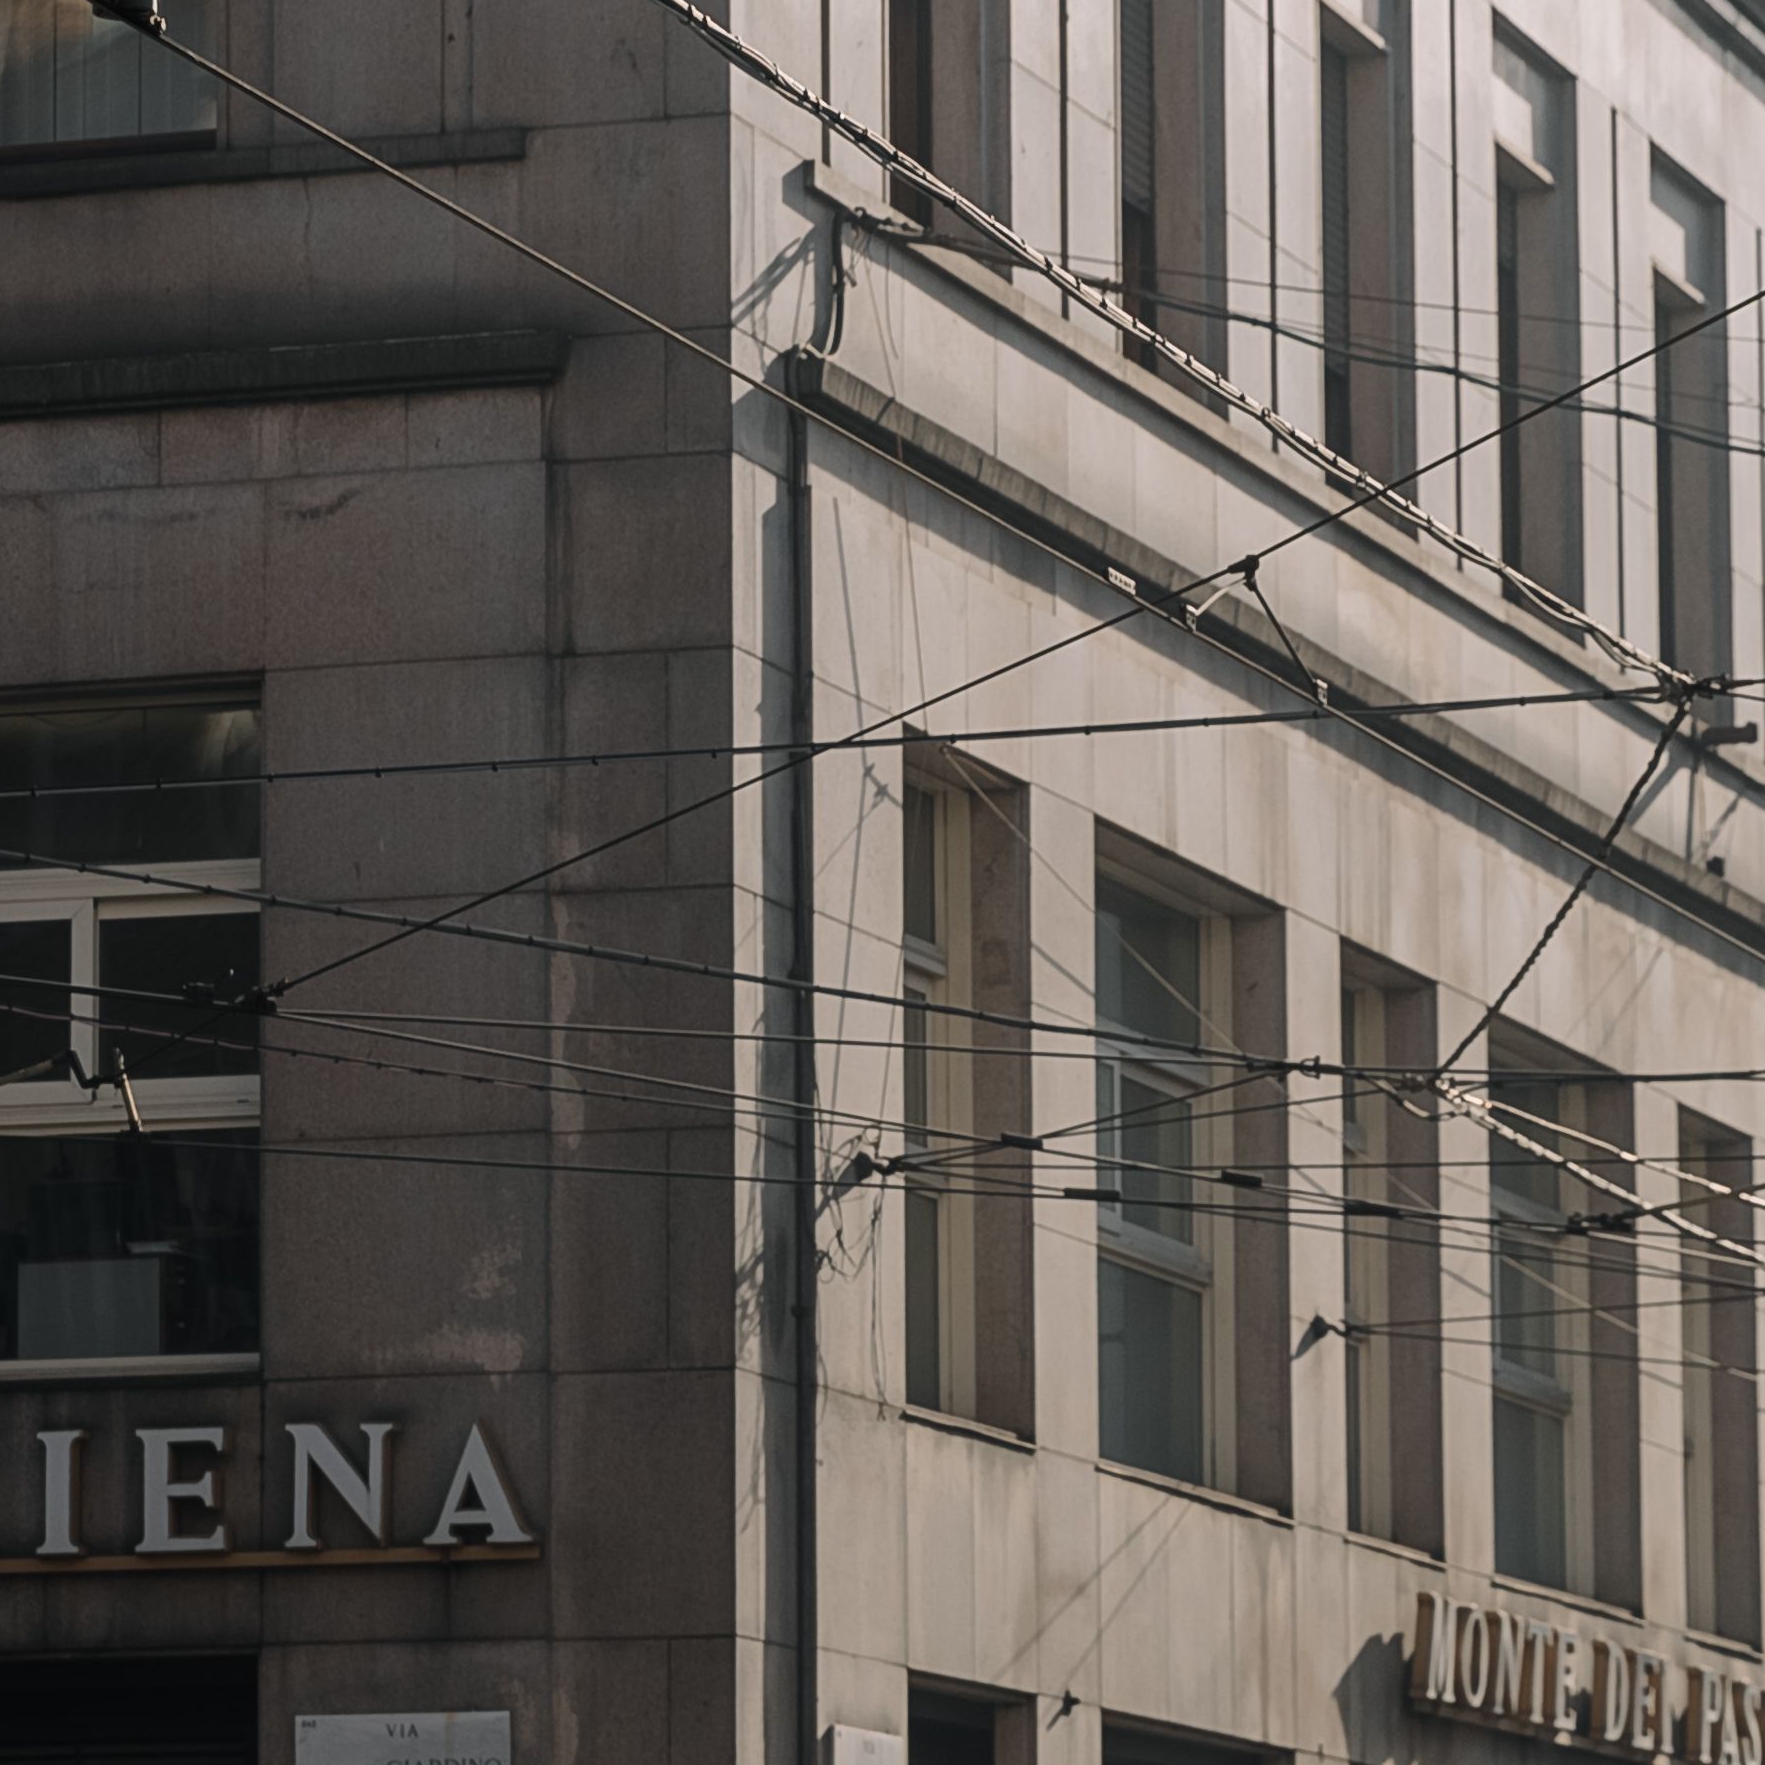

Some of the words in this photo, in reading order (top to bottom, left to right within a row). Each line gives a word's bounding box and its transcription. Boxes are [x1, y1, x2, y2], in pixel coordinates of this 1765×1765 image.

[1416, 1590, 1578, 1732] MONTE
[1596, 1639, 1674, 1754] DEI
[386, 1723, 420, 1739] VIA
